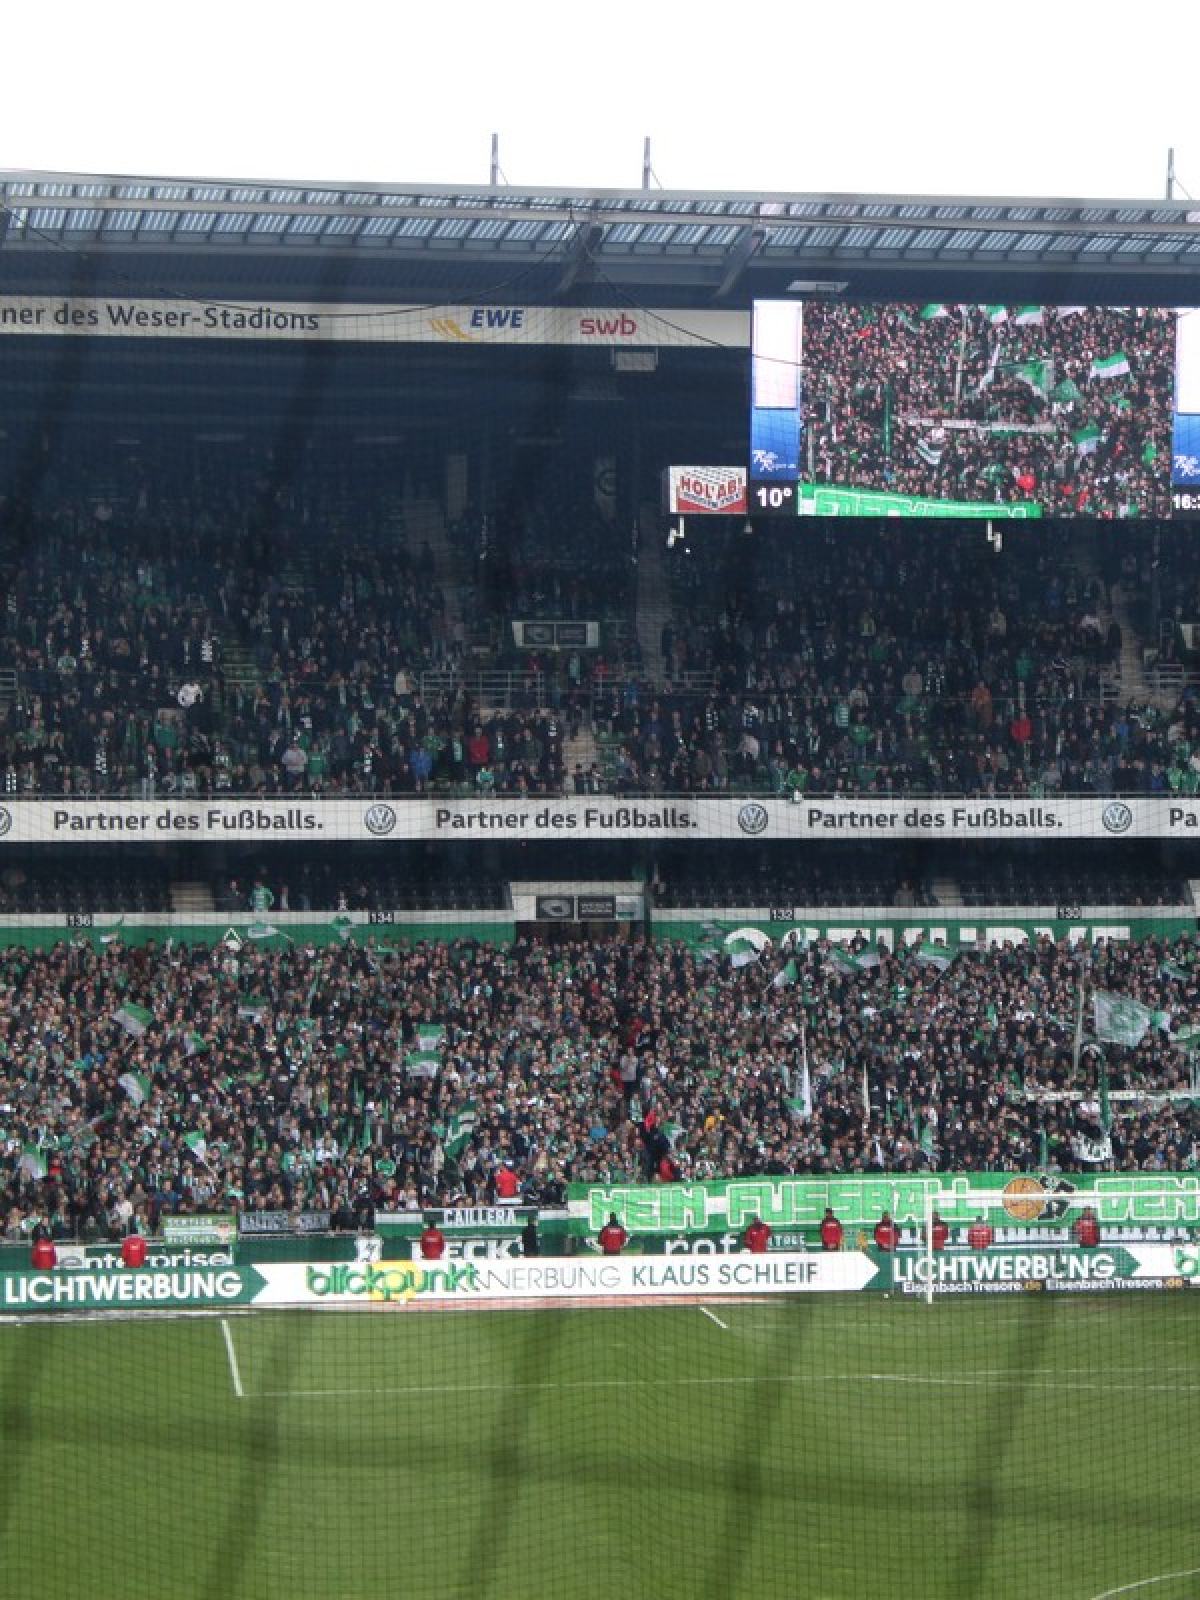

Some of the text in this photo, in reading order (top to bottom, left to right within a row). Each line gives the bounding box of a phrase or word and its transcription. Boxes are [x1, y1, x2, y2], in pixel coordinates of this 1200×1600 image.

[53, 302, 99, 326] des
[106, 304, 319, 331] Weser-Stadions
[470, 308, 525, 329] EWE
[579, 313, 637, 335] swb
[756, 487, 793, 508] 10°
[54, 808, 323, 831] Partner des Fußballs.
[436, 807, 698, 829] Partner des Fußballs.
[807, 806, 1064, 829] Partner des Fußballs.
[726, 1177, 989, 1227] FUSSBALL
[1095, 1177, 1199, 1221] DEN
[5, 1272, 243, 1303] LICHTWERBUNG
[306, 1262, 481, 1301] blickpunkt
[631, 1263, 710, 1287] KLAUS
[719, 1262, 818, 1285] SCHLEIF
